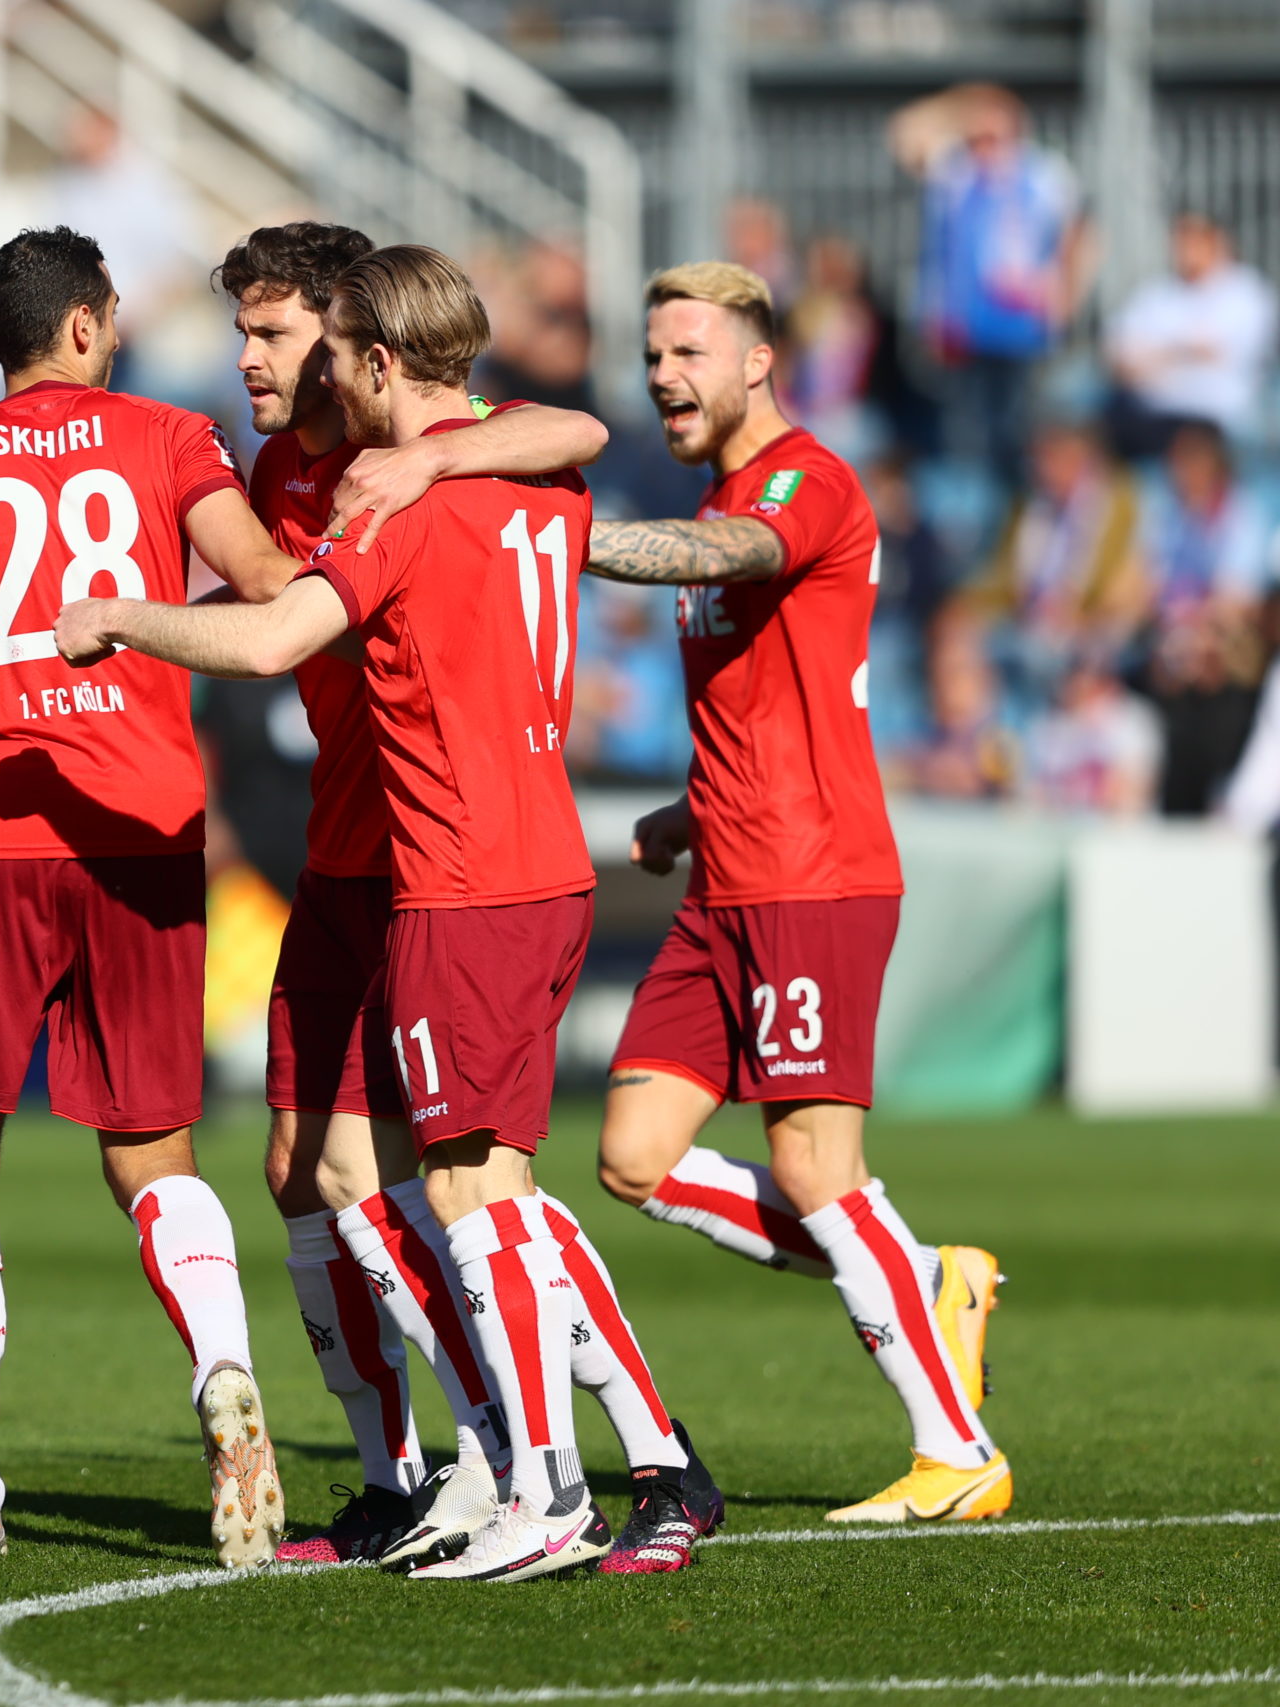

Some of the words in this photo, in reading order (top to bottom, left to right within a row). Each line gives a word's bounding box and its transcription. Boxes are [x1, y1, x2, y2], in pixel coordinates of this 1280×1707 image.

[500, 509, 569, 700] 11
[18, 692, 38, 719] 1.
[40, 688, 72, 717] FC
[72, 681, 125, 713] KÖLN
[752, 976, 823, 1058] 23
[391, 1017, 440, 1102] 11
[767, 1058, 826, 1076] uhlsport
[412, 1101, 449, 1124] sport
